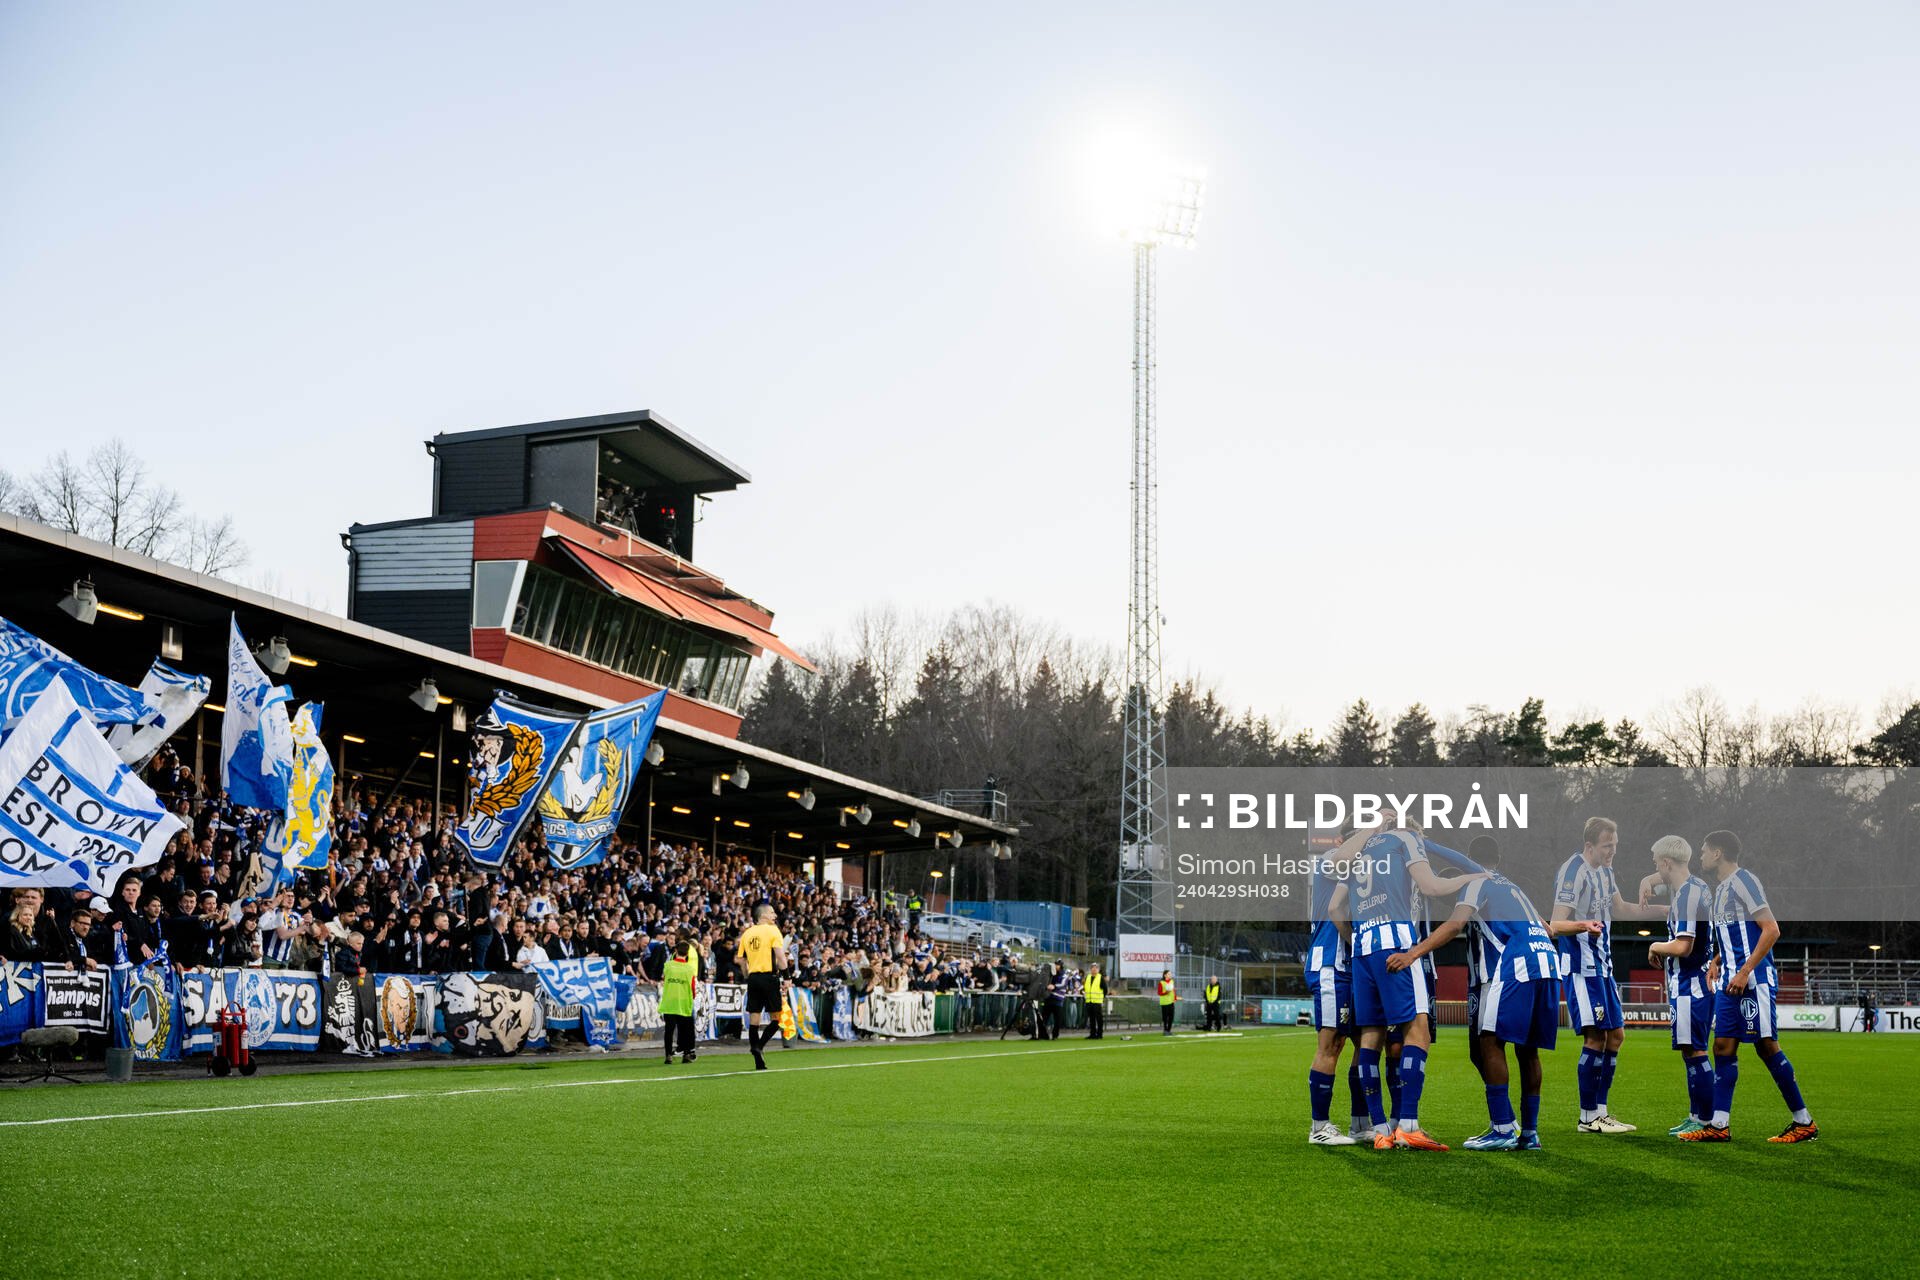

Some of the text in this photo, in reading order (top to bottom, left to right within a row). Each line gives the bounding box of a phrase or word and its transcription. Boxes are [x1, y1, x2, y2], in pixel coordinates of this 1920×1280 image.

[25, 755, 158, 843] BROWN
[1, 786, 60, 848] EST.
[1355, 854, 1373, 898] 9
[1130, 953, 1173, 962] BAUHAUS
[47, 986, 101, 1008] hampus
[275, 983, 317, 1026] 73
[1640, 1012, 1658, 1021] TILL
[1741, 998, 1758, 1020] MG
[1793, 1013, 1826, 1023] coop
